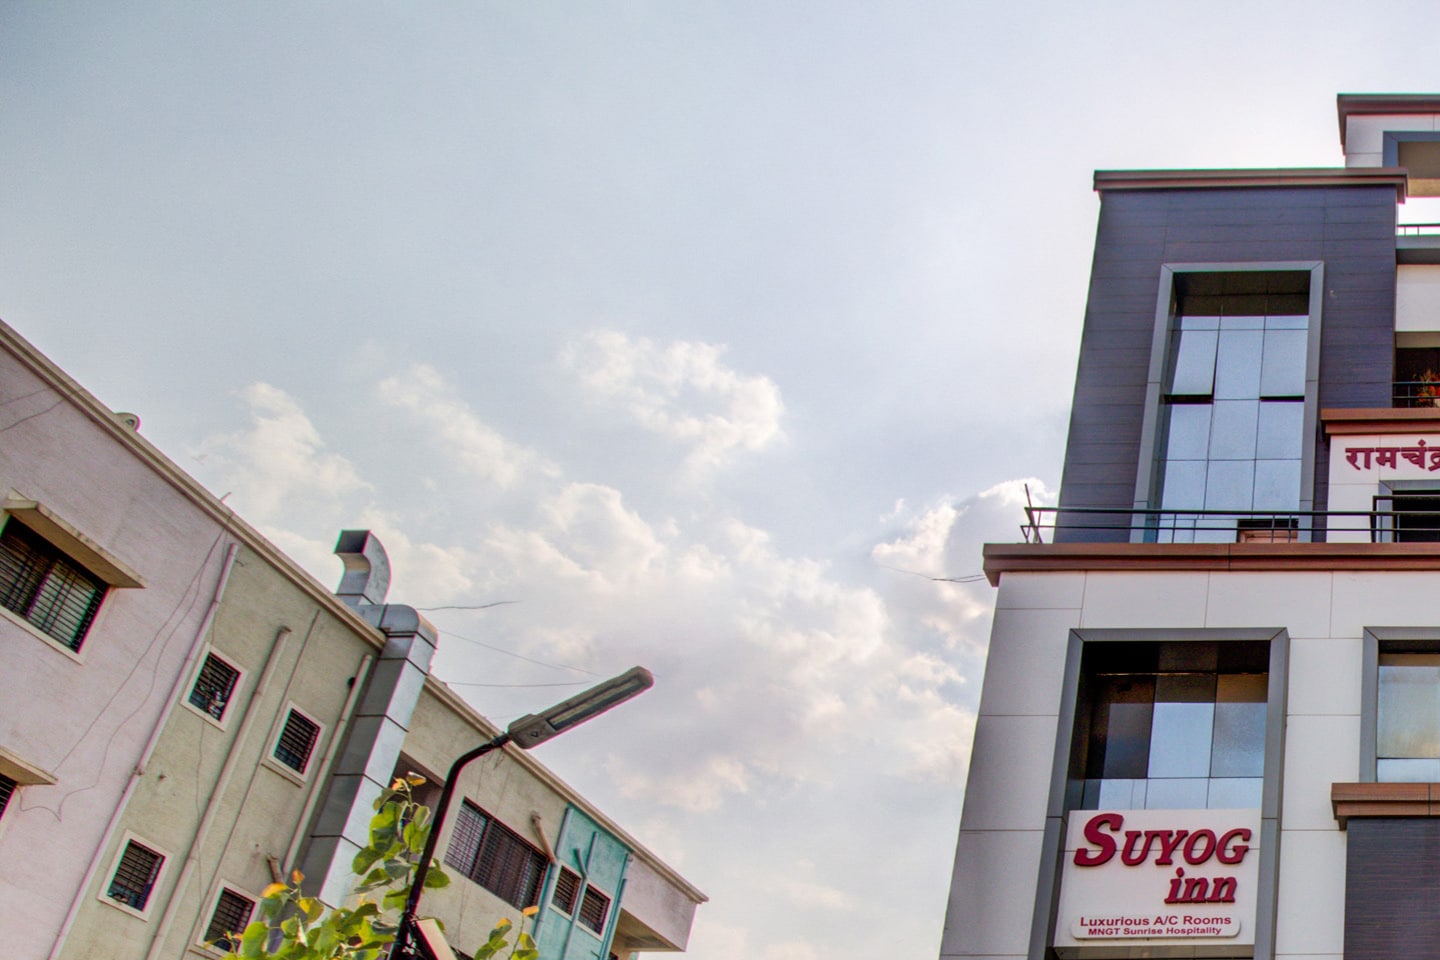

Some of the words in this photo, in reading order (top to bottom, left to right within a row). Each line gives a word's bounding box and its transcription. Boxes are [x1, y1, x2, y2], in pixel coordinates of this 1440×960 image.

[1073, 813, 1252, 867] SUYOG
[1164, 866, 1238, 905] inn
[1080, 916, 1150, 927] Luxurious
[1153, 915, 1178, 926] A/C
[1183, 915, 1231, 926] Rooms
[1088, 927, 1120, 936] MNGT
[1123, 926, 1163, 935] Sunrise
[1166, 926, 1222, 936] Hospitality
